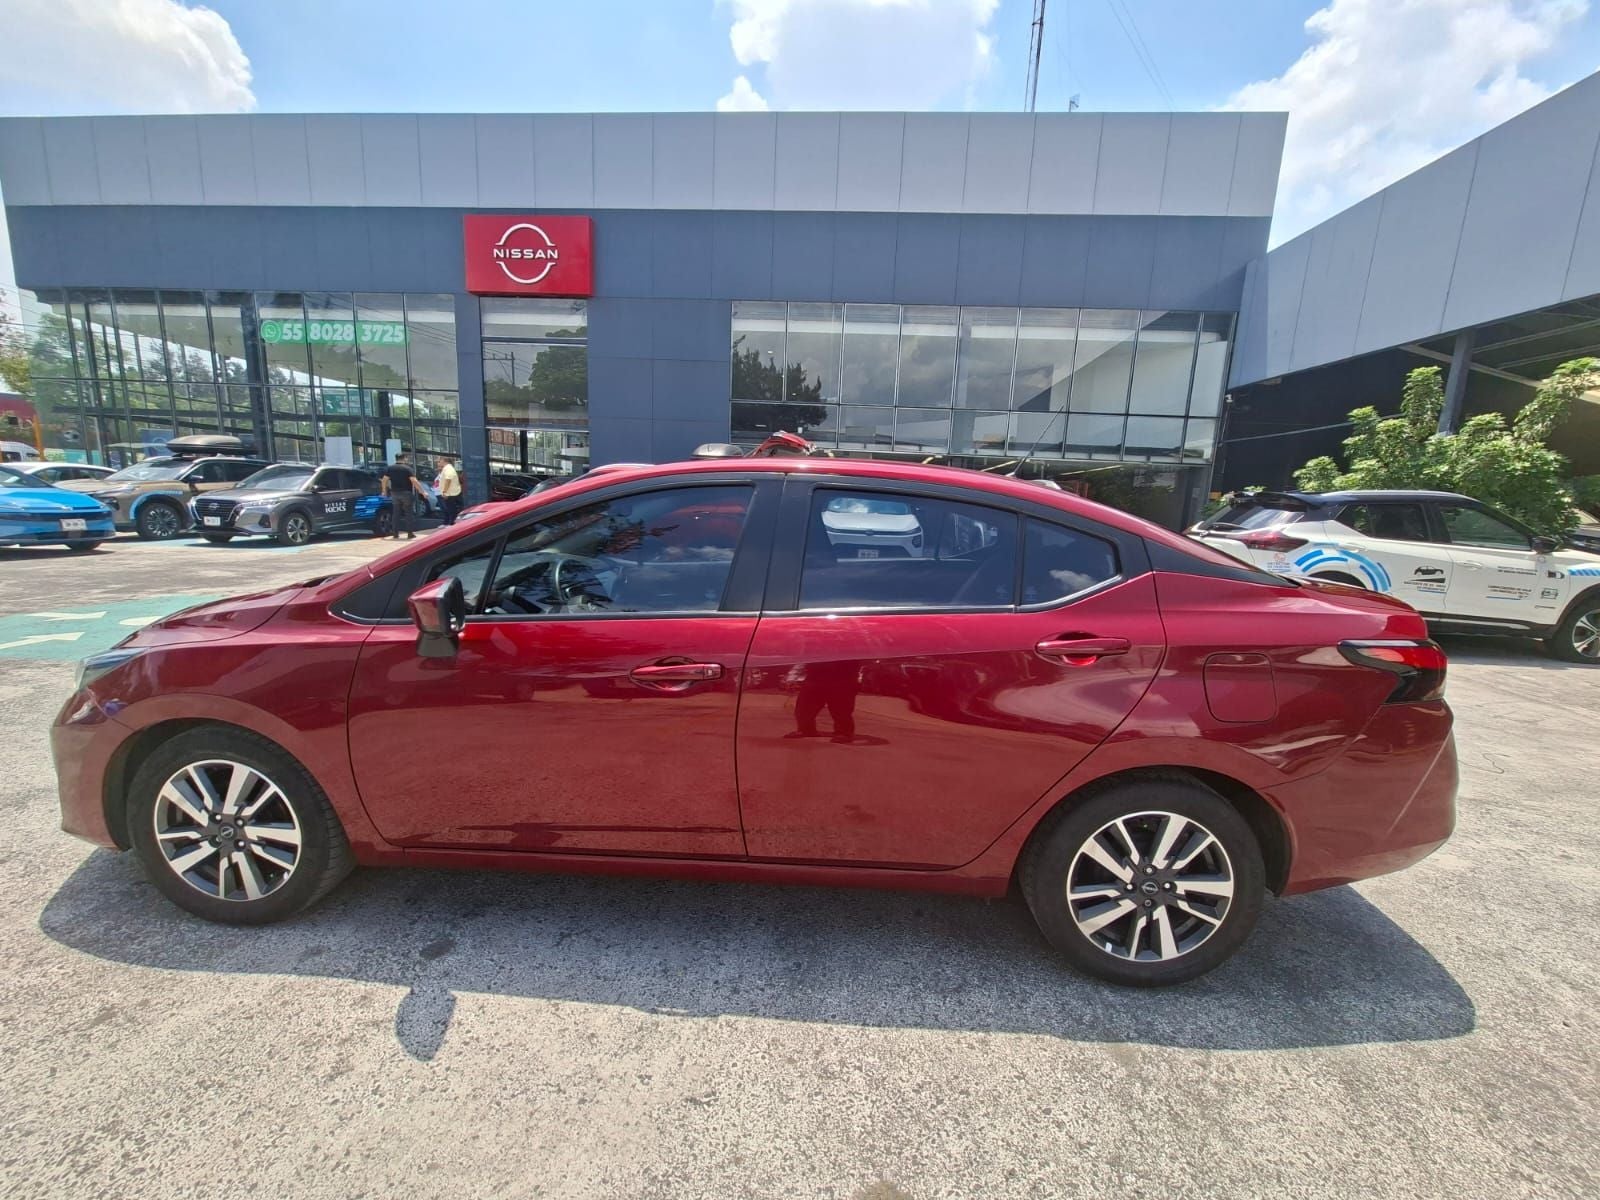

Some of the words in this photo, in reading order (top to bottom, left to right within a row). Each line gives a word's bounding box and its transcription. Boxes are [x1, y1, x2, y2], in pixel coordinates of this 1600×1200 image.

[493, 248, 558, 260] NISSAN
[282, 322, 304, 342] 55
[309, 323, 355, 342] 8028
[361, 324, 405, 343] 3725
